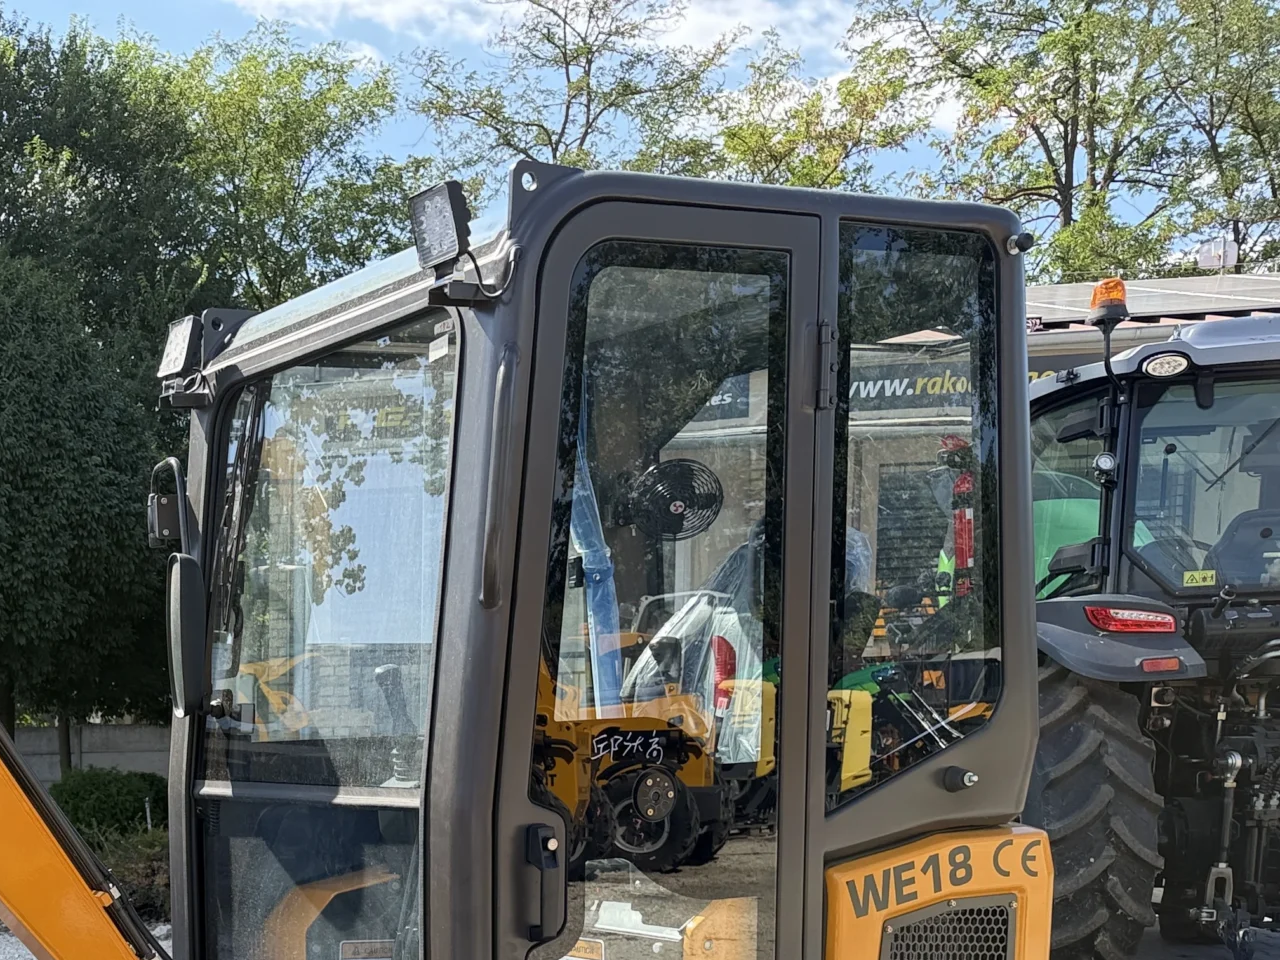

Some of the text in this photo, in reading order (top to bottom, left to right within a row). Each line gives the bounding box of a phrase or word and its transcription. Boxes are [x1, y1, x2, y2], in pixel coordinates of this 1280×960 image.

[849, 370, 971, 398] ww.rako
[846, 839, 1041, 919] WE18 CE
